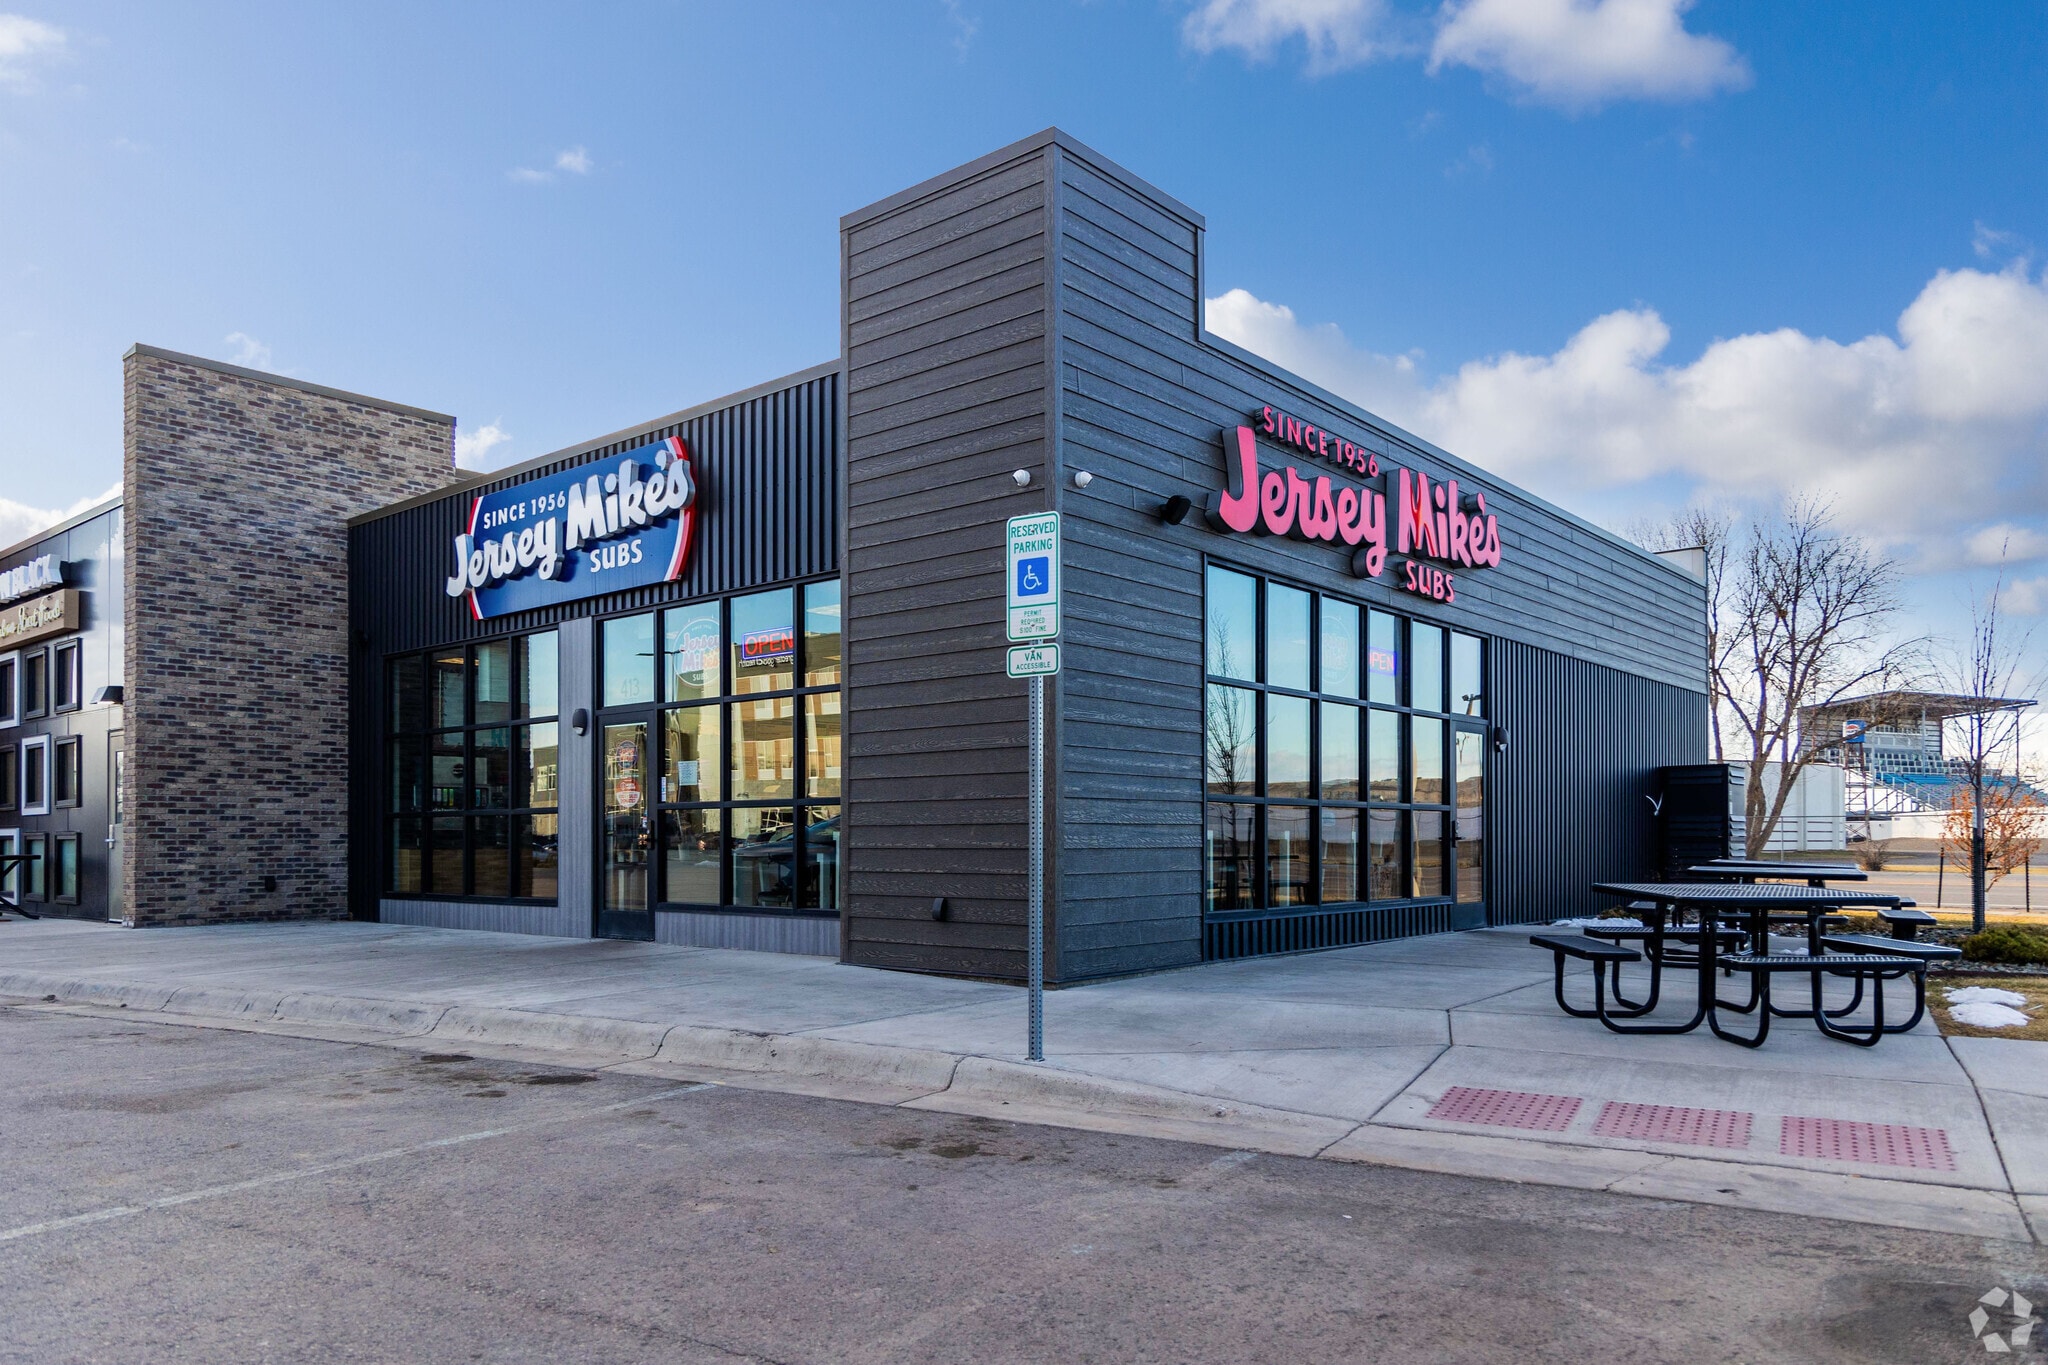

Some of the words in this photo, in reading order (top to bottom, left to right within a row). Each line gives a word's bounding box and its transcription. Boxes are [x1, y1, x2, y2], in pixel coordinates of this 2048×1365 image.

[1263, 405, 1328, 456] SINCE
[1335, 438, 1379, 478] 1956
[484, 501, 526, 529] SINCE
[531, 490, 566, 517] 1956
[1219, 425, 1388, 577] Jersey
[1397, 468, 1502, 568] Mike's
[446, 517, 560, 598] Jersey
[566, 449, 693, 550] Mike's
[1011, 521, 1055, 538] RESERVED
[590, 539, 643, 573] SUBS
[1014, 538, 1052, 554] PARKING
[1405, 560, 1455, 603] SUBS
[1024, 609, 1042, 617] PERMIT
[745, 631, 794, 655] OPEN
[1025, 652, 1042, 662] VAN
[1016, 661, 1051, 671] ACCESSIBLE
